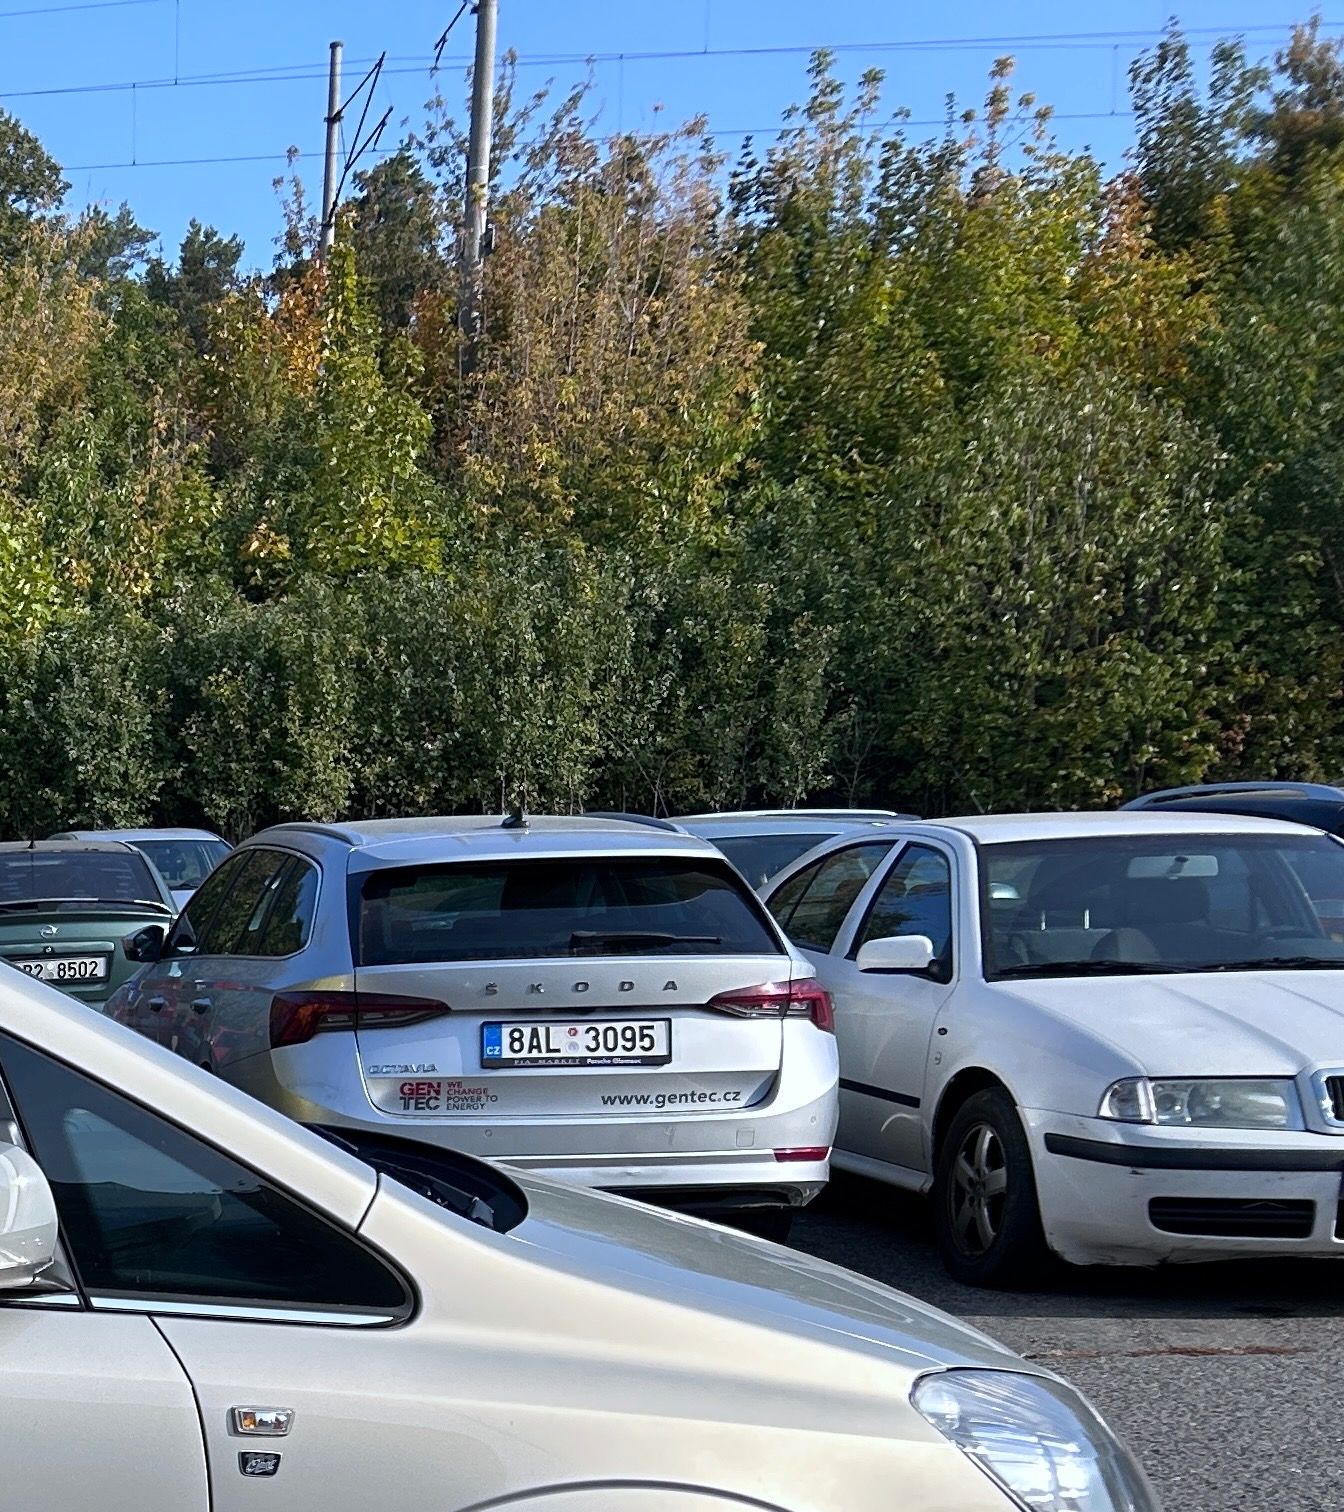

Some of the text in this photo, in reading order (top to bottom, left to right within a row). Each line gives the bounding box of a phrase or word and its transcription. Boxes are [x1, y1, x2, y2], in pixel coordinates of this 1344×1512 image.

[57, 961, 98, 978] 8502
[485, 980, 678, 996] ŠKODA
[508, 1025, 655, 1054] 8AL 3095
[486, 1046, 500, 1055] CZ
[399, 1082, 442, 1096] GEN
[399, 1096, 440, 1111] TEC
[446, 1103, 485, 1111] ENERGY
[601, 1090, 741, 1109] www.gentec.cz
